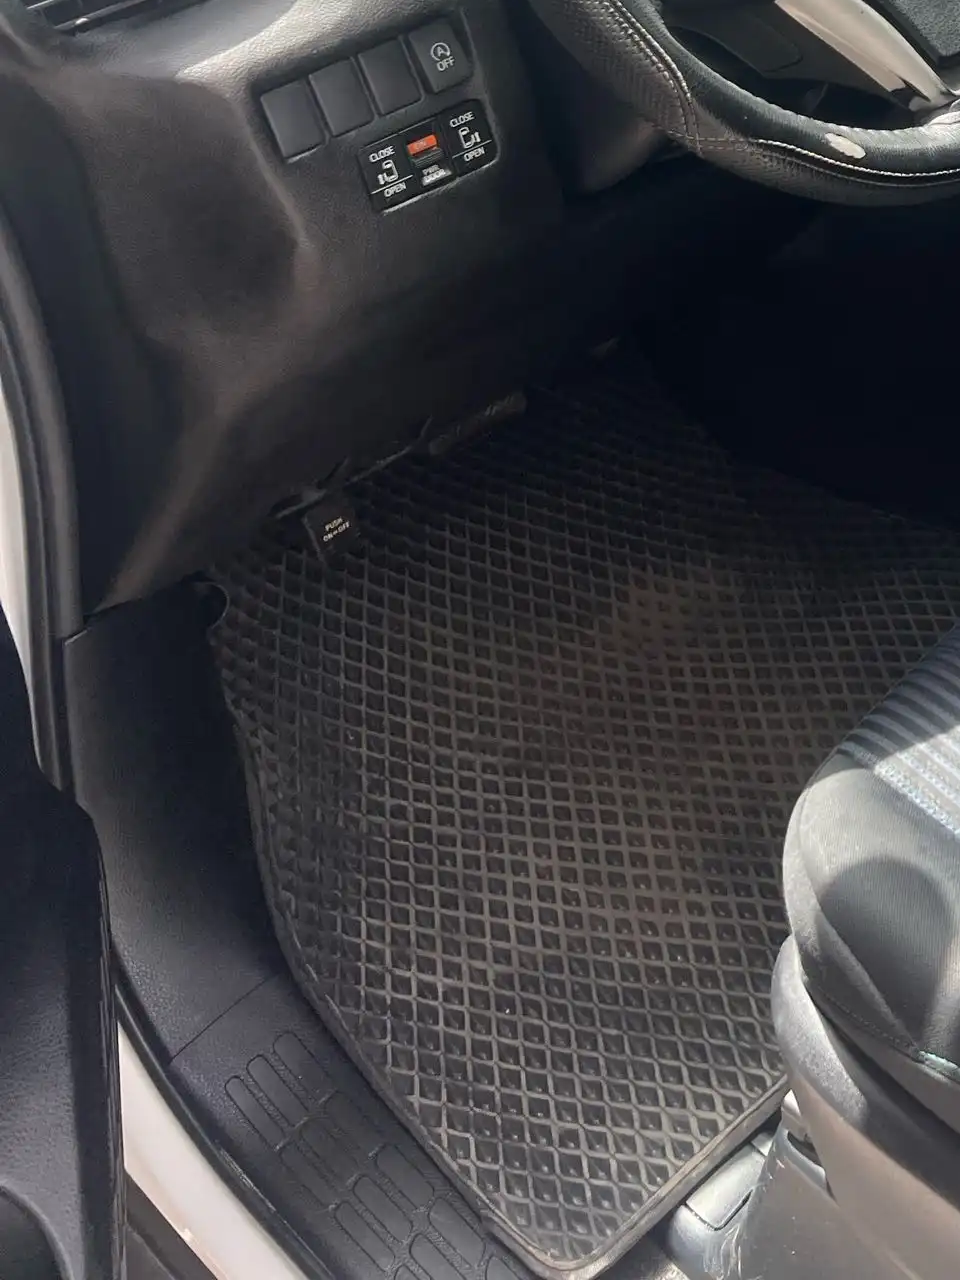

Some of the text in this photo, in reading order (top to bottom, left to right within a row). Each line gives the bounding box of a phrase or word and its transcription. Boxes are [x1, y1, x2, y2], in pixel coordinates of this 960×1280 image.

[436, 55, 455, 71] OFF
[449, 111, 475, 128] CLOSE
[368, 145, 396, 163] CLOSE
[463, 146, 485, 162] OPEN
[383, 181, 407, 198] OPEN
